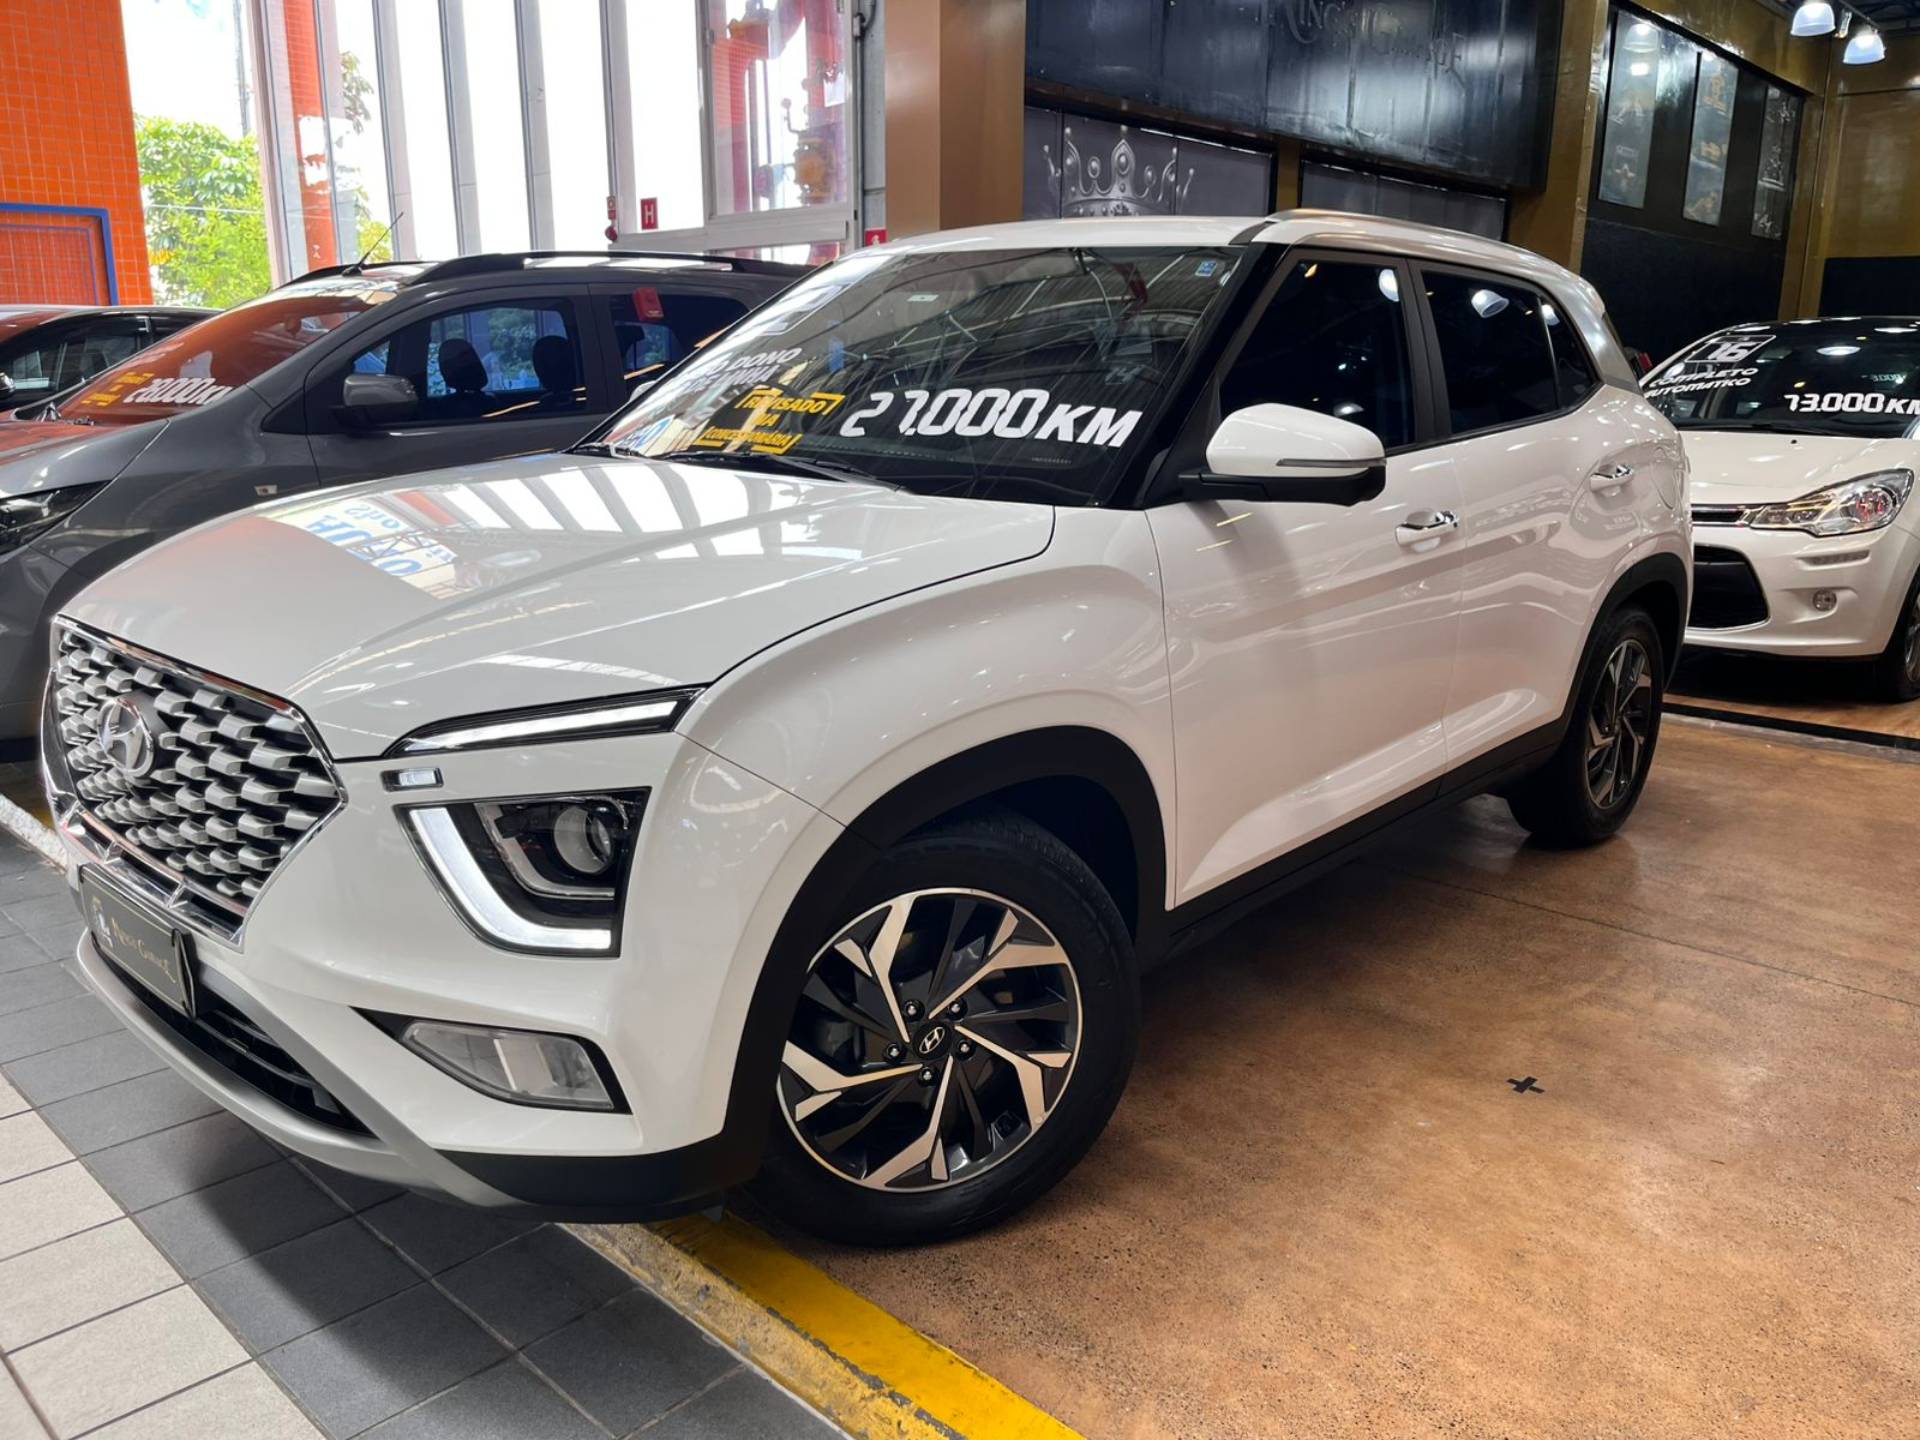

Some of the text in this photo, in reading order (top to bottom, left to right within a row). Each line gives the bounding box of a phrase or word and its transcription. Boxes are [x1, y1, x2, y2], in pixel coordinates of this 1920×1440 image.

[726, 347, 802, 372] DONO
[1708, 341, 1757, 362] 16
[1649, 367, 1760, 388] COMPLETO
